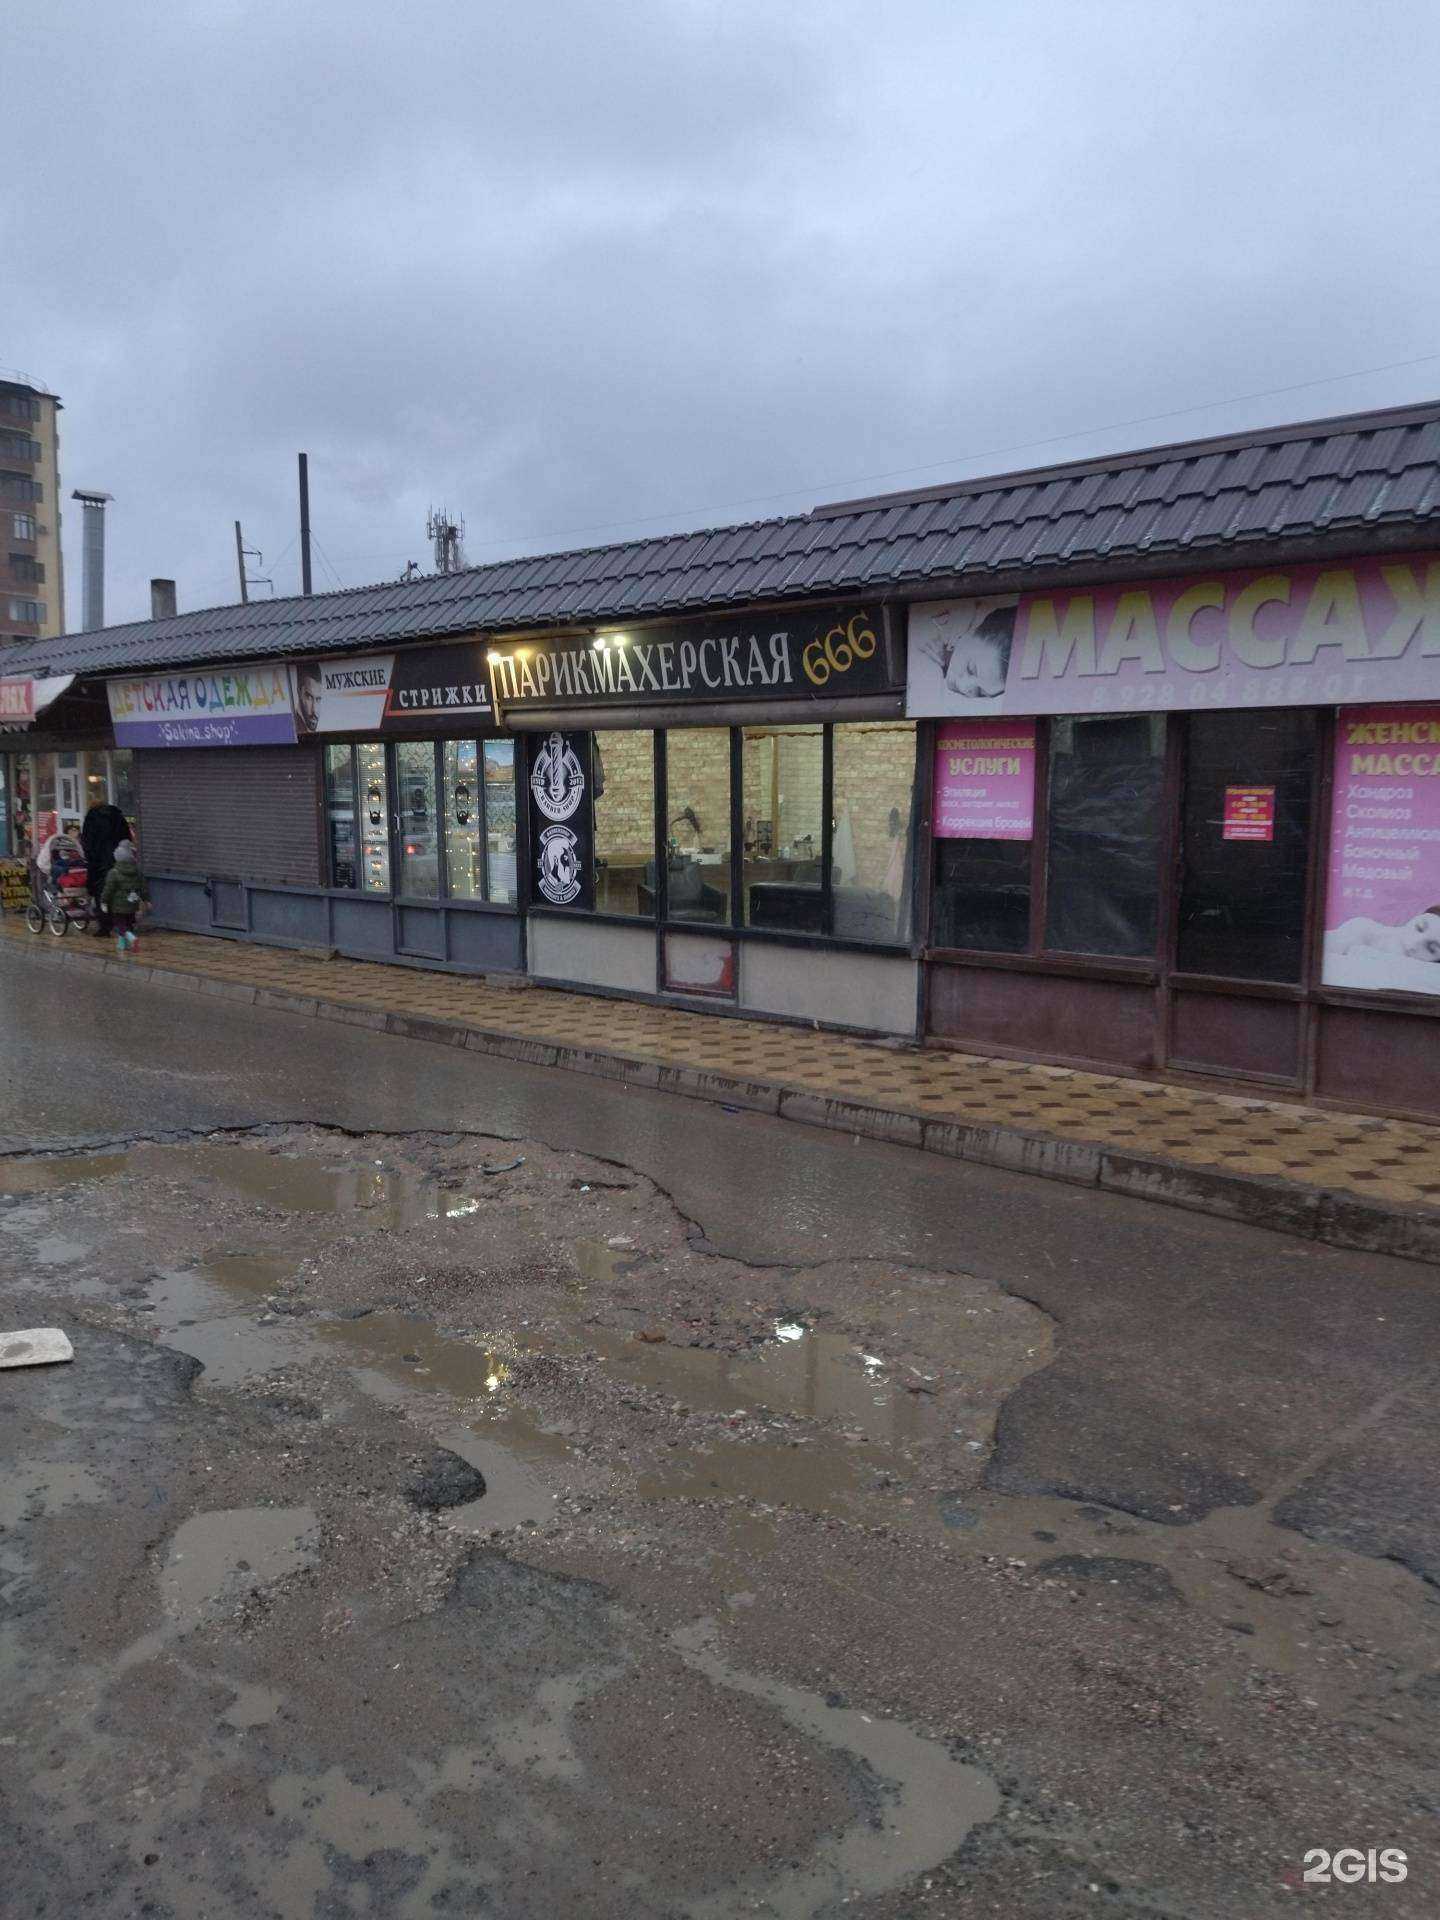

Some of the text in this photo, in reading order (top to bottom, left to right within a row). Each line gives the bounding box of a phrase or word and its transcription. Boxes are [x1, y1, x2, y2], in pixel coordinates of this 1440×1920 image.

[500, 612, 877, 698] ПАРИКМАХЕРСКАЯ 666
[325, 669, 385, 690] МУЖСКИЕ
[114, 670, 285, 714] ДЕТСКАЯ ОДЕЖДА
[399, 684, 487, 707] СТРИЖКИ
[948, 757, 1021, 775] УСЛУГИ
